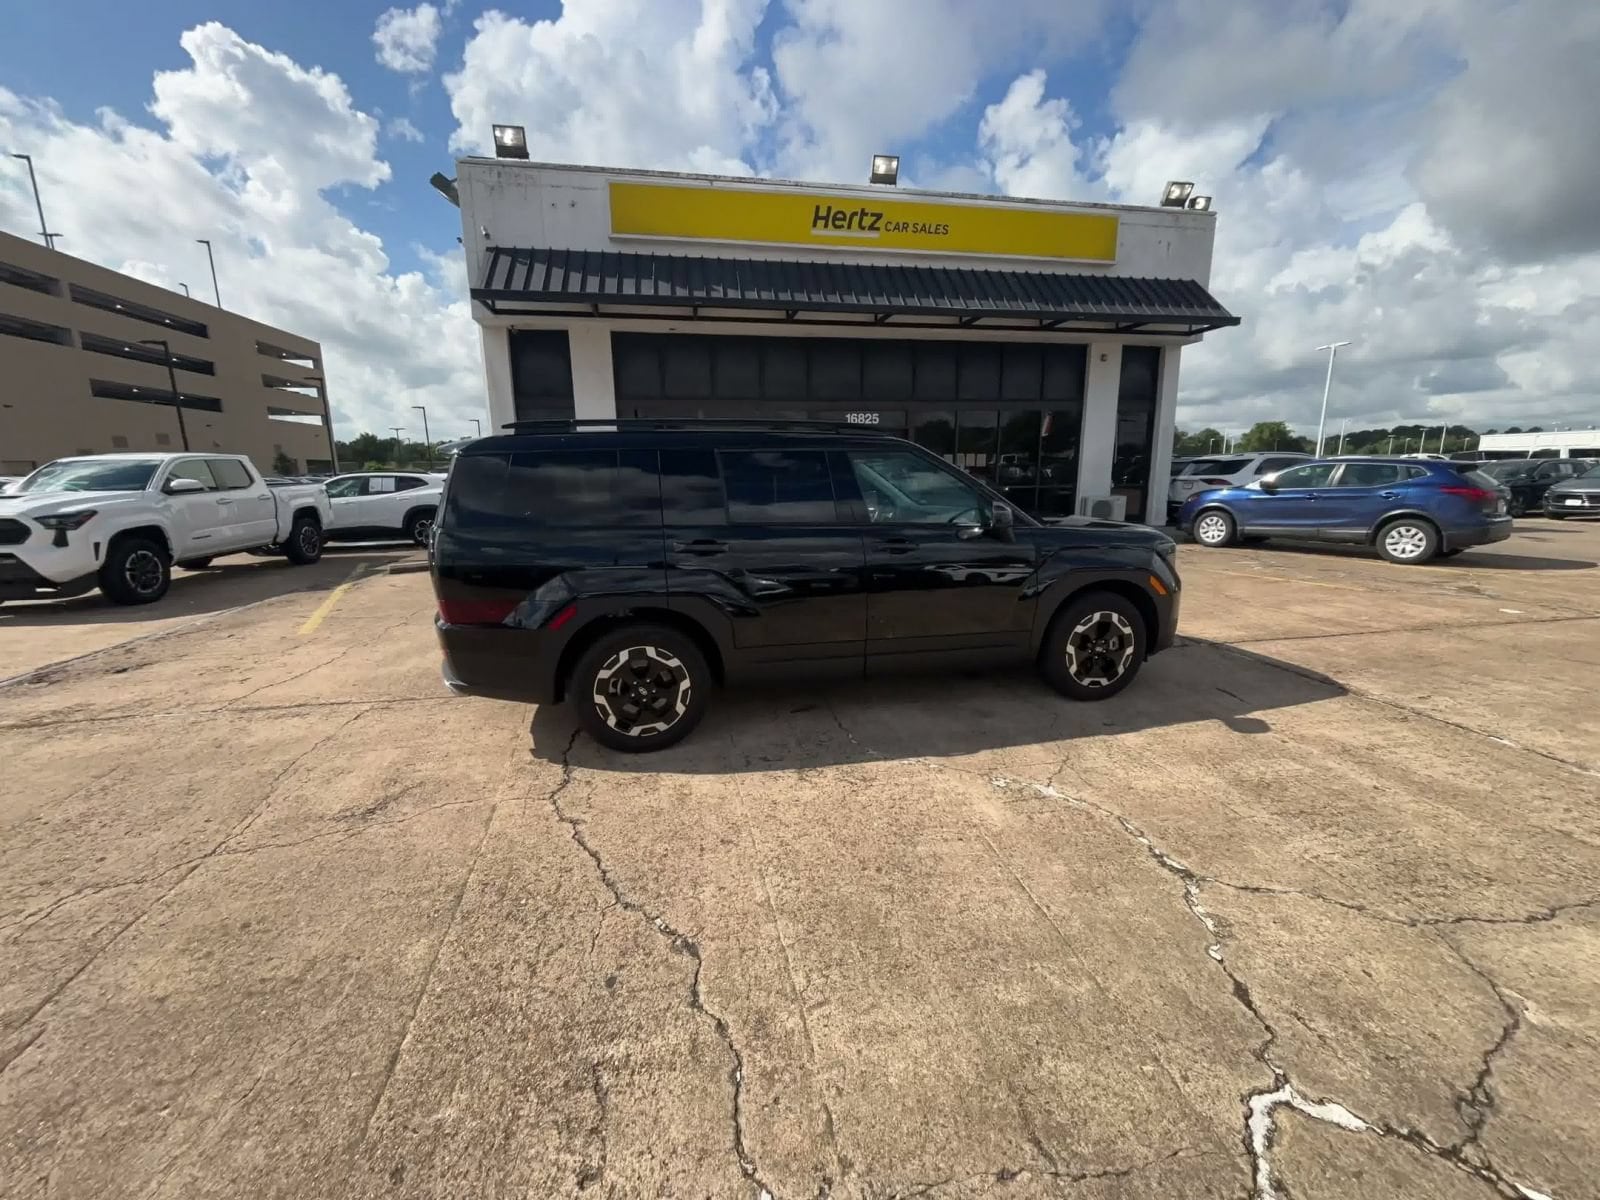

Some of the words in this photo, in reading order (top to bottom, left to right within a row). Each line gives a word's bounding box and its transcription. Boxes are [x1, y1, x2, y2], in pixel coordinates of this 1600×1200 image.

[812, 205, 883, 231] Hertz
[884, 221, 909, 233] CAR
[912, 222, 949, 235] SALES
[845, 413, 880, 424] 16825
